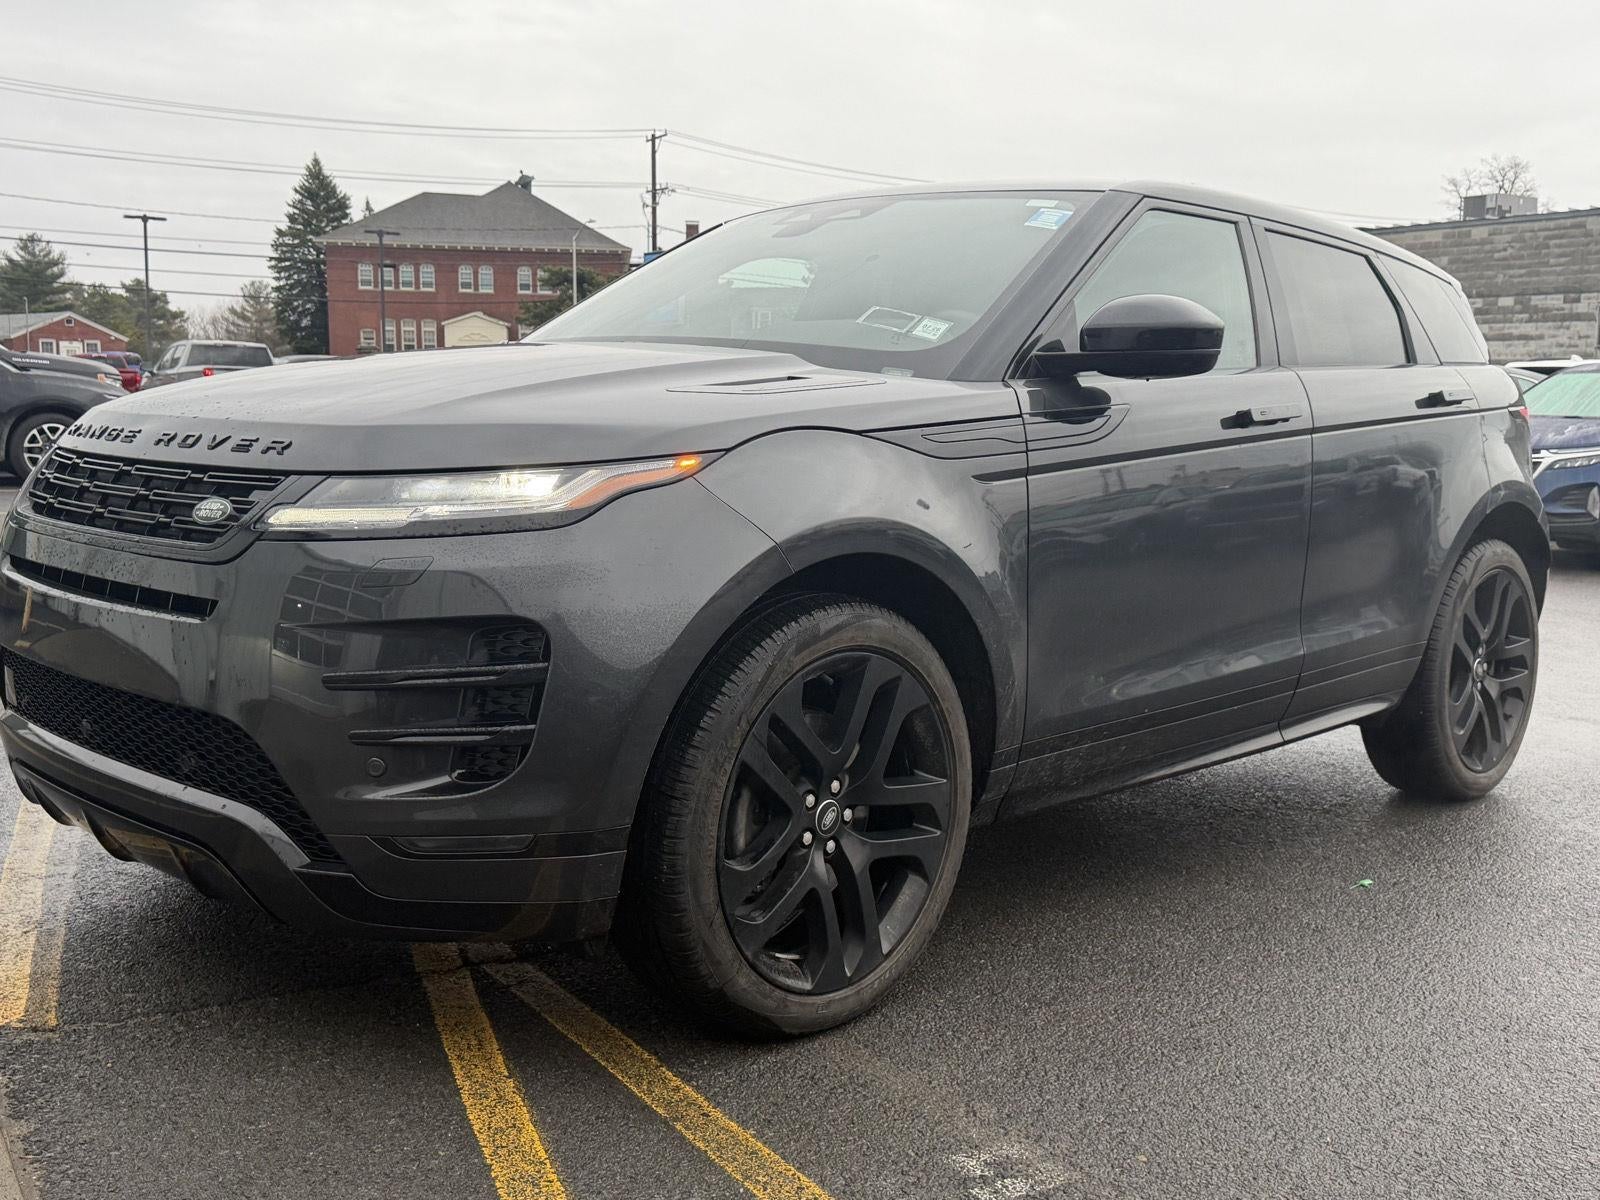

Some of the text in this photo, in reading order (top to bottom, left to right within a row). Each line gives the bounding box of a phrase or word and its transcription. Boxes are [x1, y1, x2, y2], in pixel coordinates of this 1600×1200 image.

[67, 423, 293, 456] RANGE ROVER
[198, 509, 223, 519] ROVER
